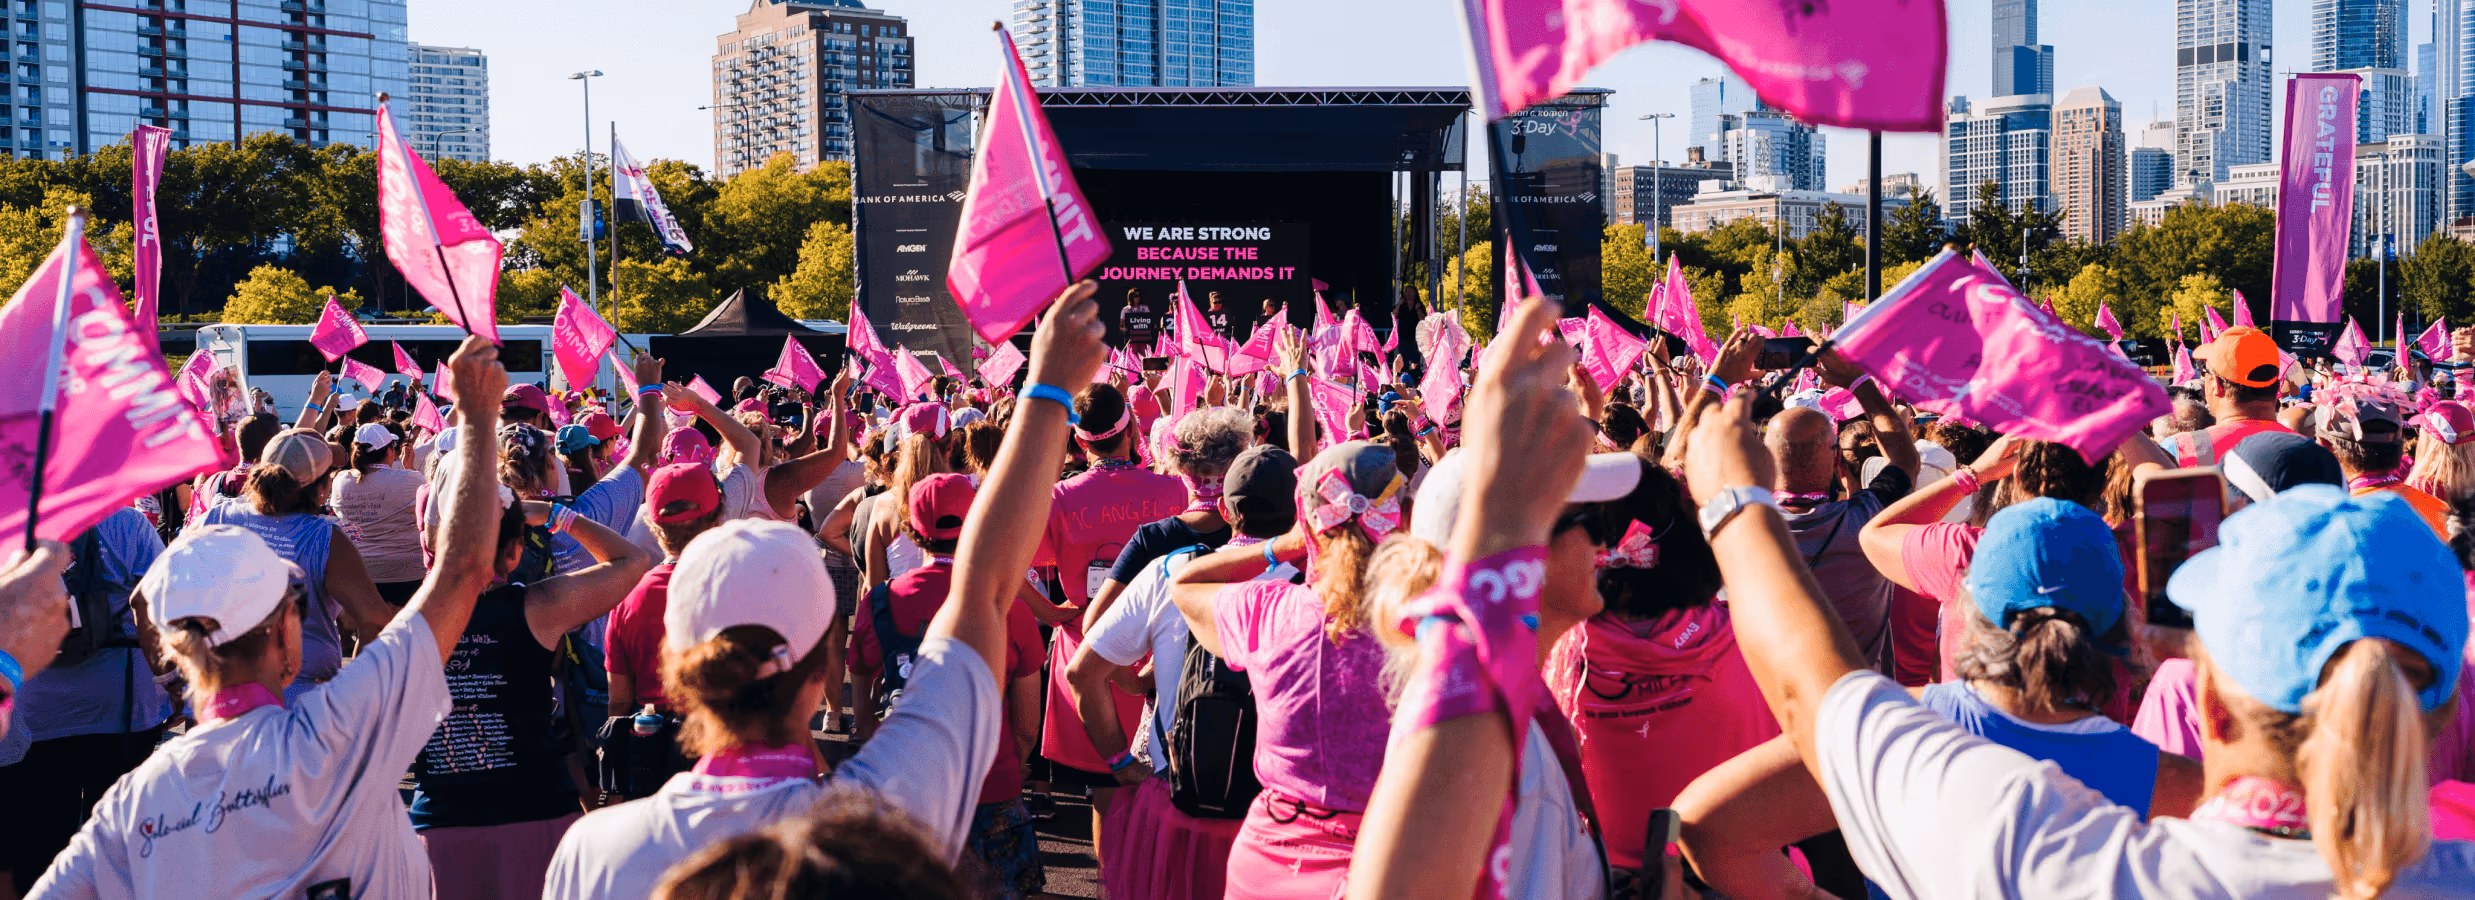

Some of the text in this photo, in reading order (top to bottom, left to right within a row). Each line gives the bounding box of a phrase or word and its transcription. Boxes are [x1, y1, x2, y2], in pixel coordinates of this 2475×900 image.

[2310, 85, 2340, 214] GRATEFUL
[883, 195, 897, 203] OF
[898, 194, 946, 203] AMERICA
[1494, 195, 1577, 204] BK OF AMERICA
[1123, 226, 1271, 241] WE ARE STRONG
[896, 244, 926, 253] AMGEN
[1137, 246, 1258, 261] BECAUSE THE
[1533, 244, 1558, 252] AMGEN
[895, 274, 930, 282] MOHAWK
[1099, 266, 1296, 280] JOURNEY DEMANDS IT
[1129, 317, 1151, 325] Living
[1209, 313, 1228, 327] 14
[890, 321, 938, 333] Walgreens
[2291, 334, 2318, 345] 3-Day
[908, 349, 938, 358] ogistics
[1101, 499, 1165, 524] ANGEL
[1674, 621, 1701, 649] Every
[204, 773, 292, 835] Butterflies
